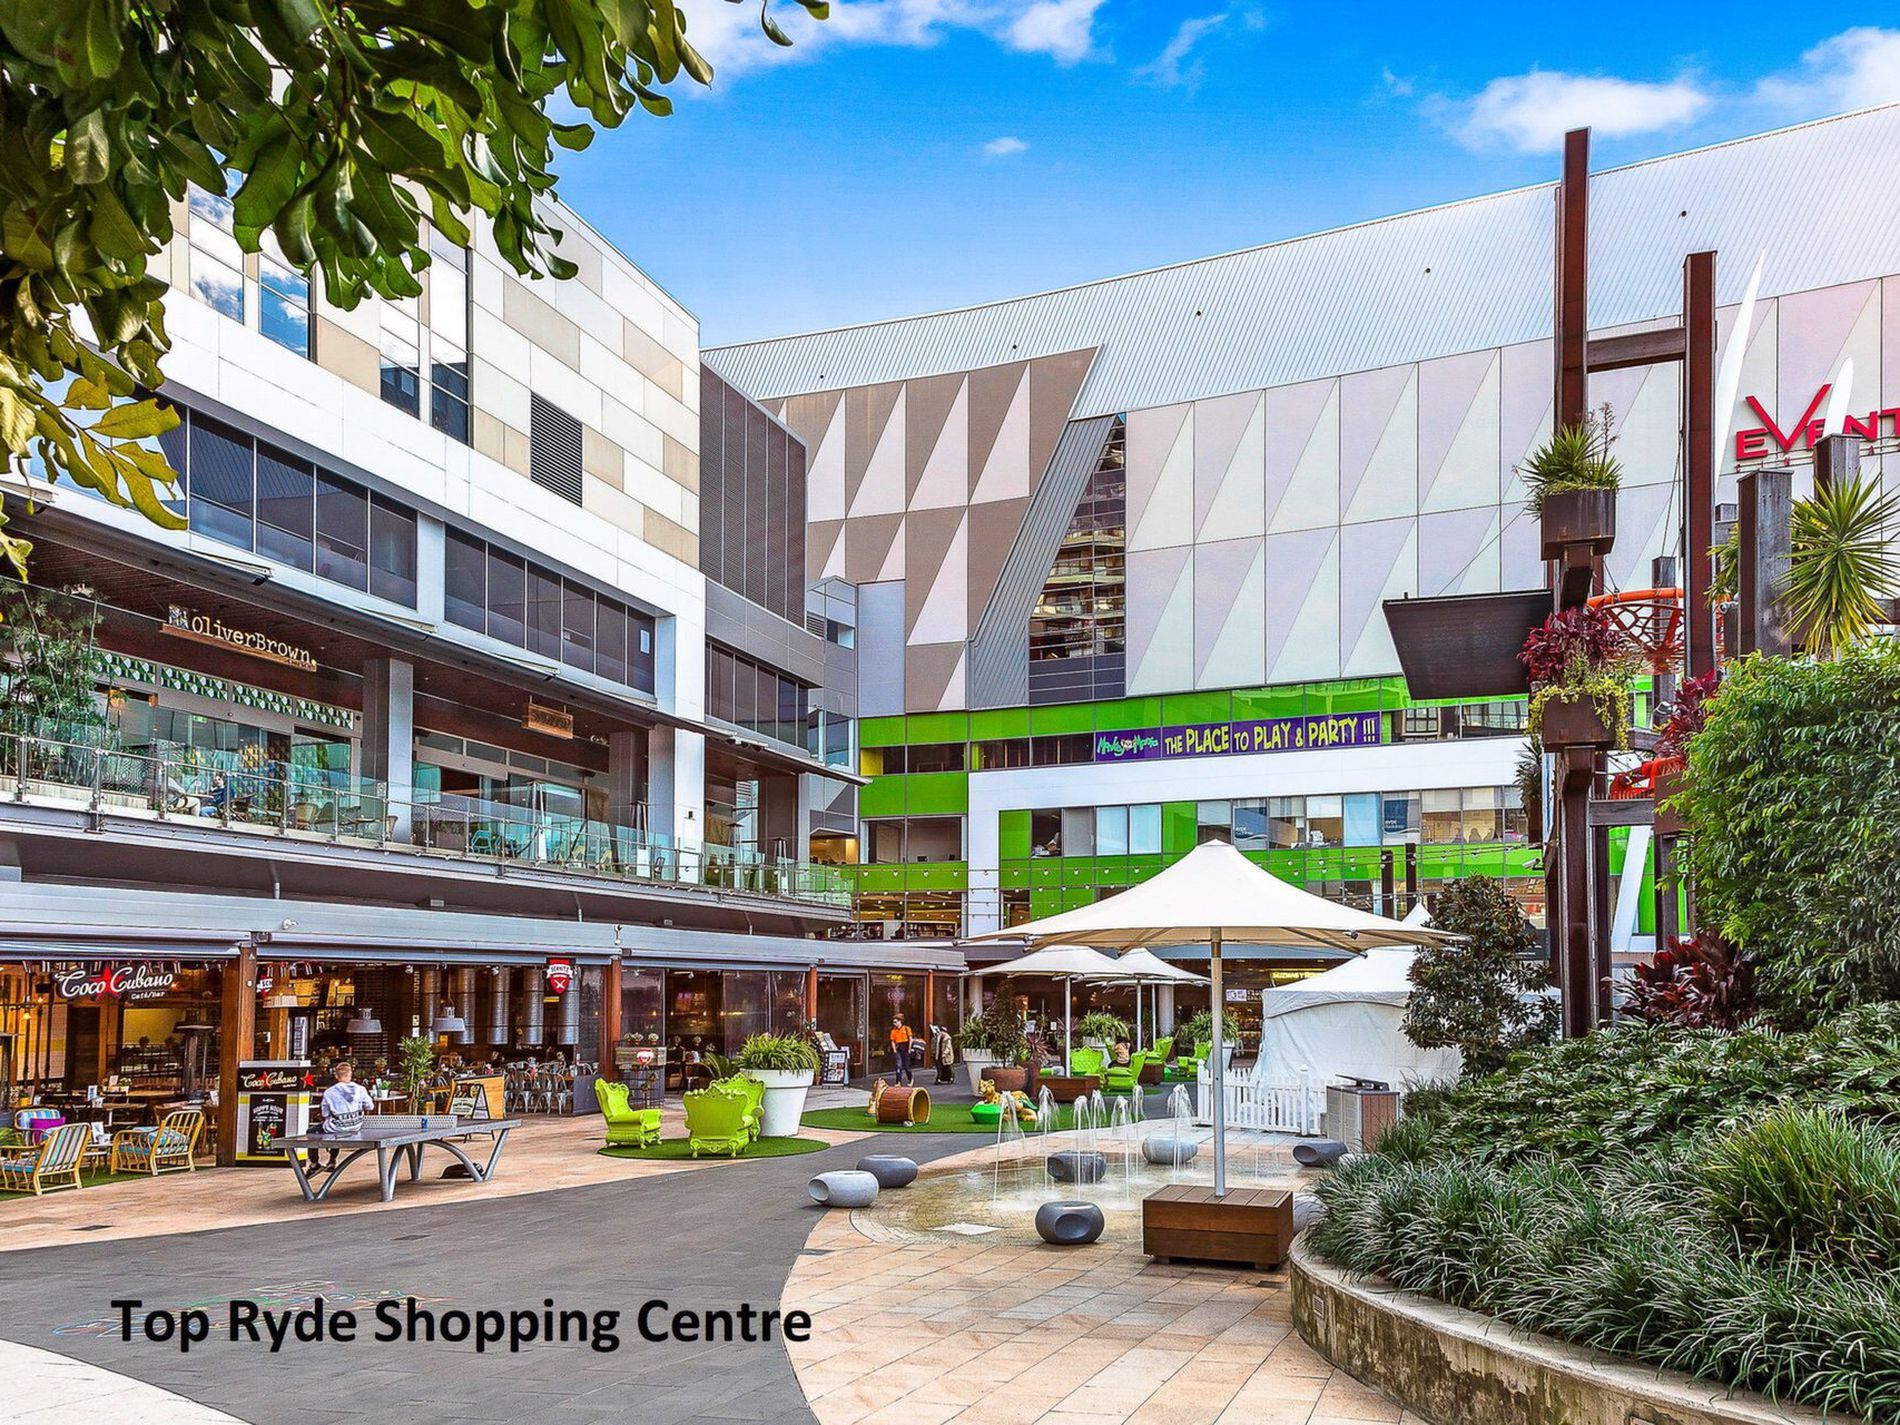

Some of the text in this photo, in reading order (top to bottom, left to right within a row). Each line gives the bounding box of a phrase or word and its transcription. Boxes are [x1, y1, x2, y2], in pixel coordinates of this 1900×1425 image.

[1164, 735, 1183, 755] THE
[1185, 726, 1229, 753] PLACE
[1234, 731, 1249, 751] TO
[1254, 721, 1291, 750] PLAY
[1295, 727, 1304, 748] &
[1308, 716, 1358, 747] PARTY
[110, 965, 173, 992] Cubano
